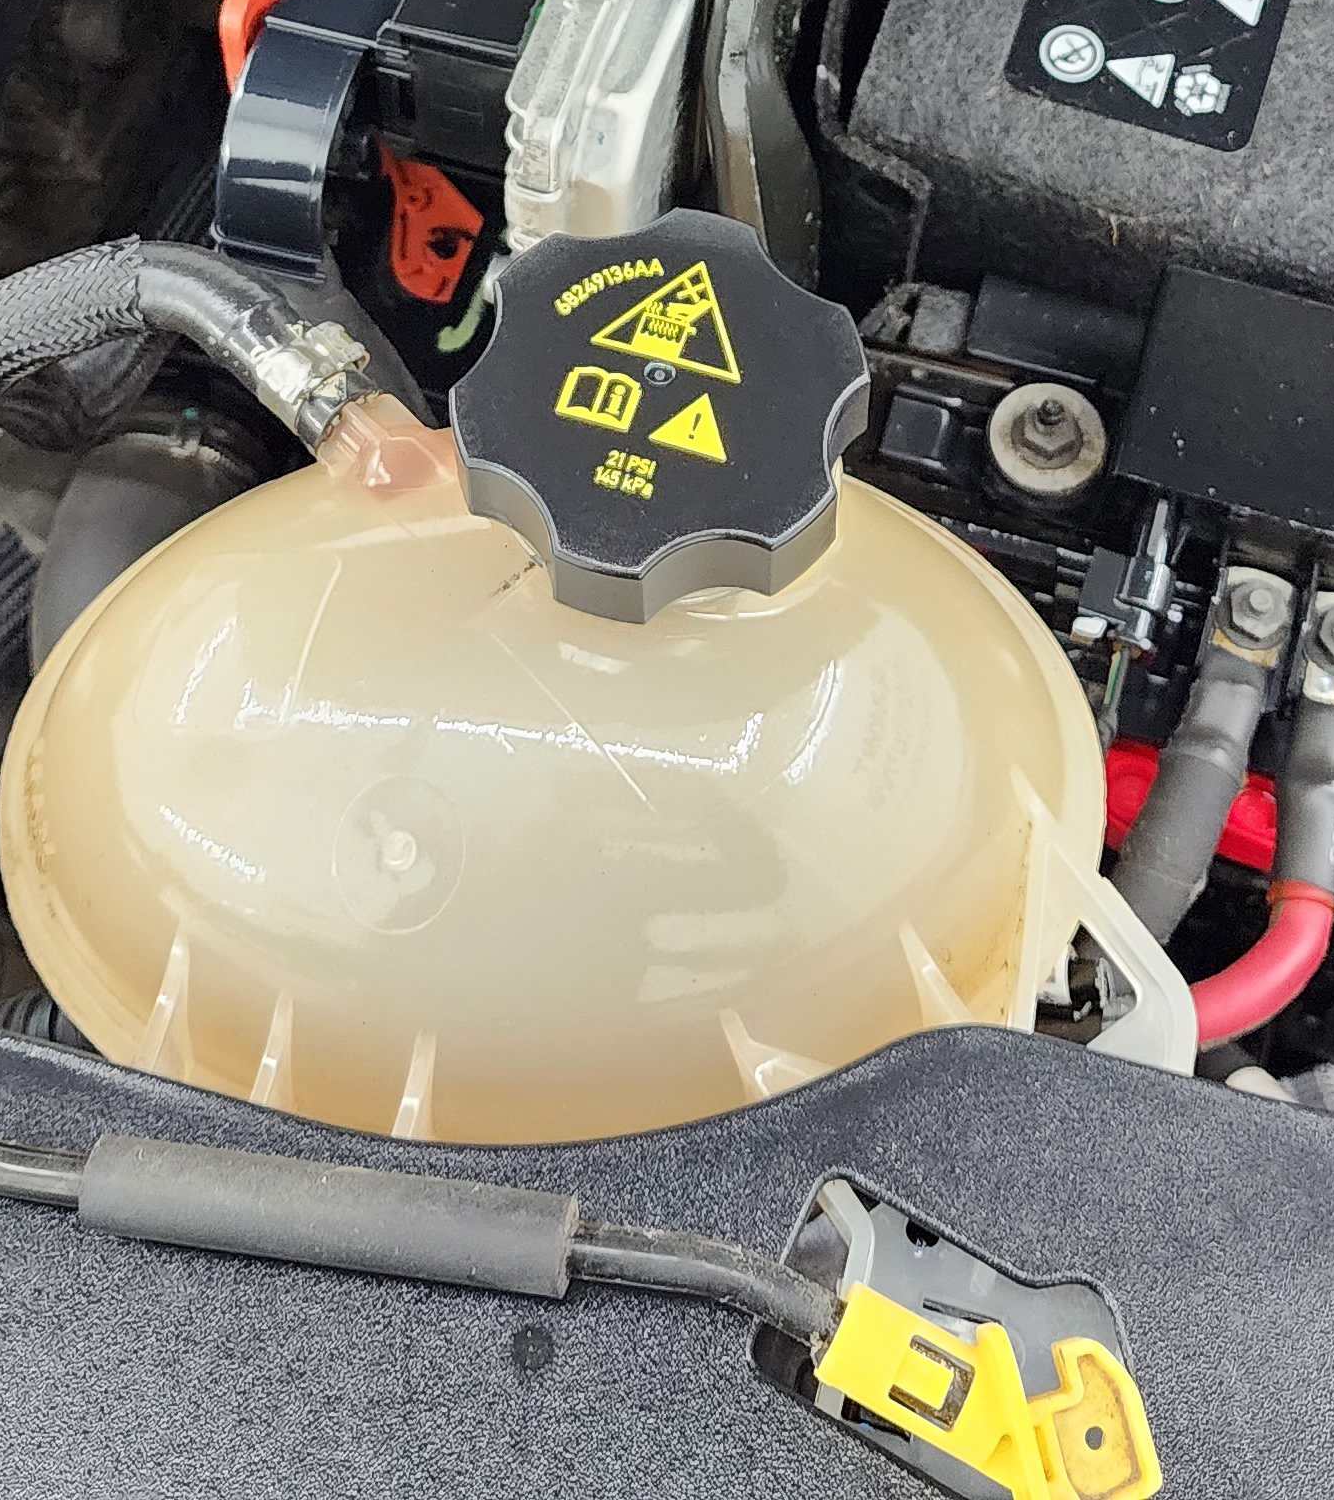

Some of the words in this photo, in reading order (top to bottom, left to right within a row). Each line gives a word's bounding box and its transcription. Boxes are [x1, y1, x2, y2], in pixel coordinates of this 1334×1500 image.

[553, 257, 665, 317] 68249136AA
[604, 449, 627, 471] 21
[625, 453, 657, 480] PSI
